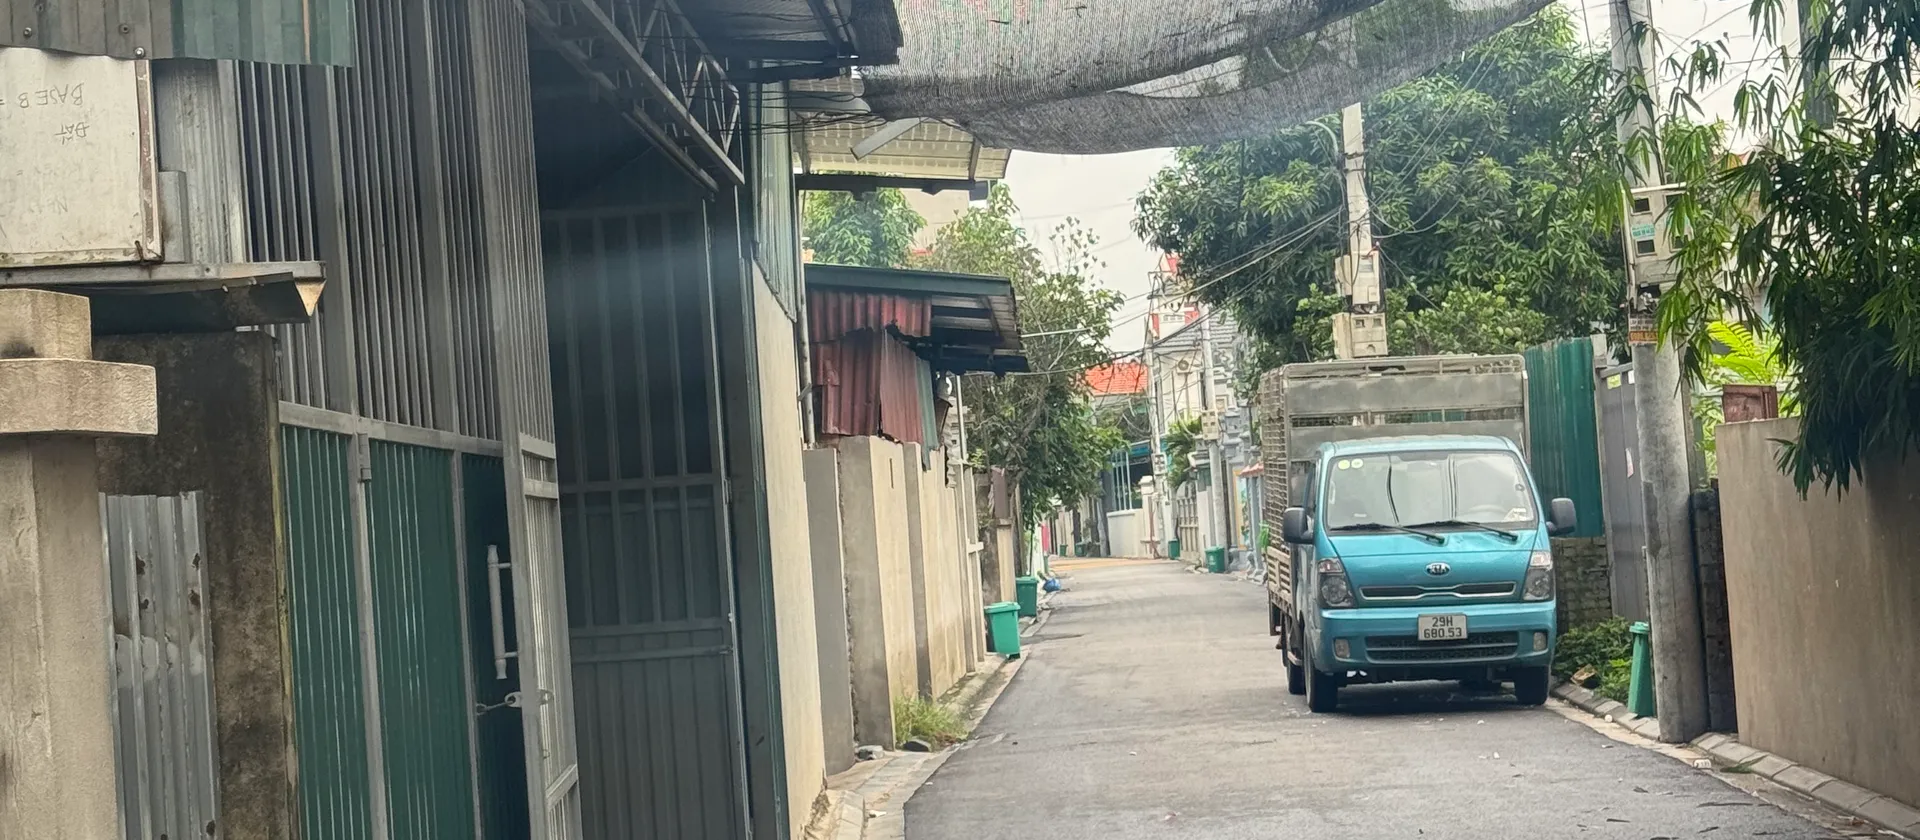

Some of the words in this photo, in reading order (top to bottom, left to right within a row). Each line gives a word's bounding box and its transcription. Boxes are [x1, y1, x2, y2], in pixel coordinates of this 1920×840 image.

[35, 82, 85, 108] BASE
[1431, 616, 1453, 627] 29H
[1423, 627, 1462, 639] 680.53
